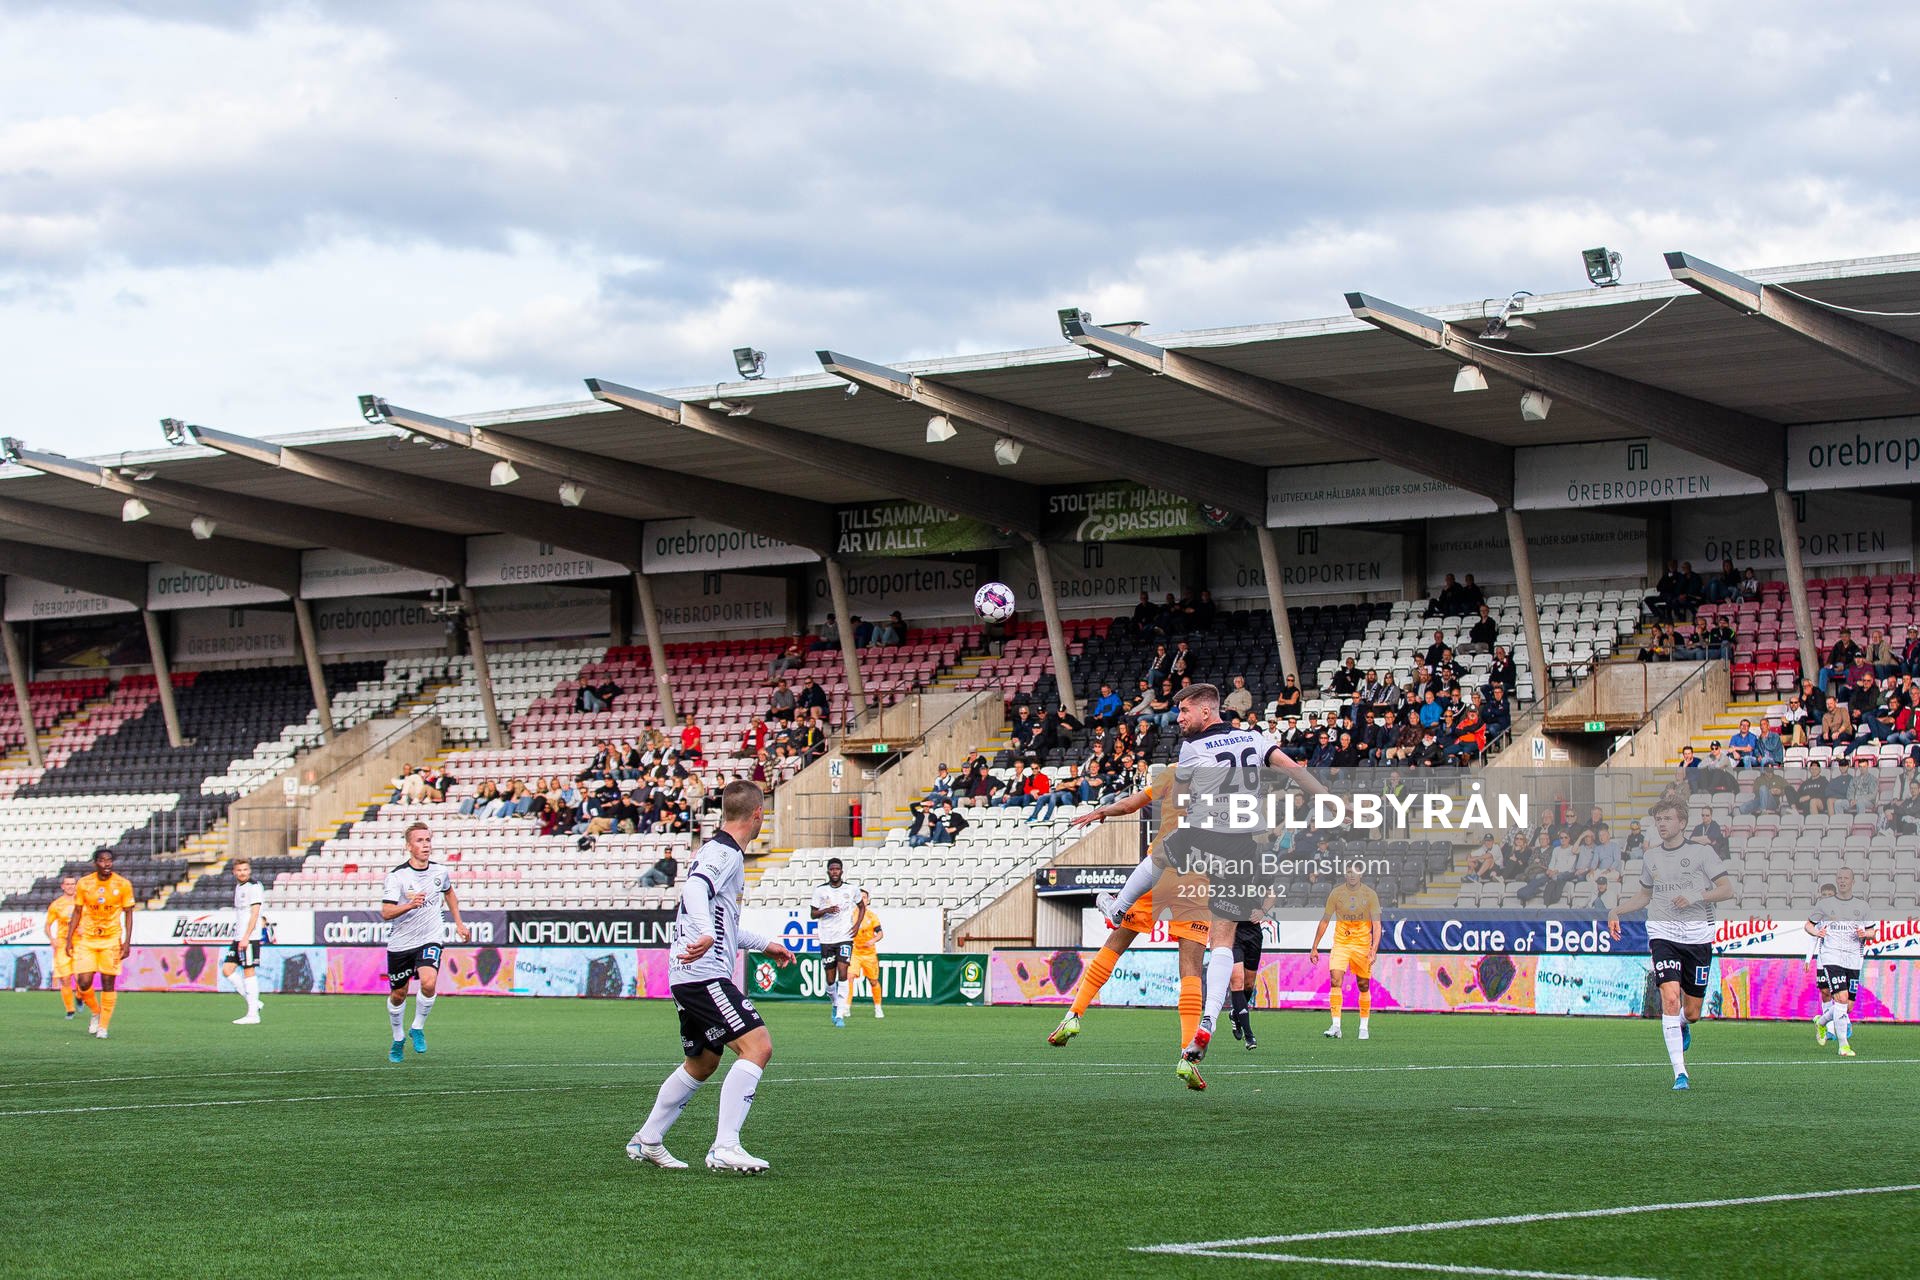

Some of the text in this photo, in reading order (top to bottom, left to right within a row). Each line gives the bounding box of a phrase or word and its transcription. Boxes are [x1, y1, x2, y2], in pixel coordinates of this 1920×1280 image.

[1271, 495, 1279, 503] VI
[1281, 491, 1324, 503] UTVECKLAR
[1326, 488, 1367, 500] HÅLLBARA
[1369, 485, 1400, 498] MILJÖER
[1402, 484, 1420, 495] SOM
[1567, 474, 1711, 502] ÖREBROPORTEN
[1119, 507, 1188, 531] PASSION
[837, 528, 928, 553] ÄR VI ALLT.
[500, 560, 593, 581] ÖREBROPORTEN
[1236, 562, 1381, 588] ÖREROPORTEN
[1027, 575, 1161, 600] ÖEBROPORTEN
[32, 597, 109, 617] ÖREBROPORTEN
[188, 634, 288, 656] ÖREBROPORTEN
[1204, 735, 1254, 750] MALMBERGS
[1534, 740, 1544, 757] M
[1215, 747, 1259, 795] 26
[1440, 920, 1611, 953] Care of Beds
